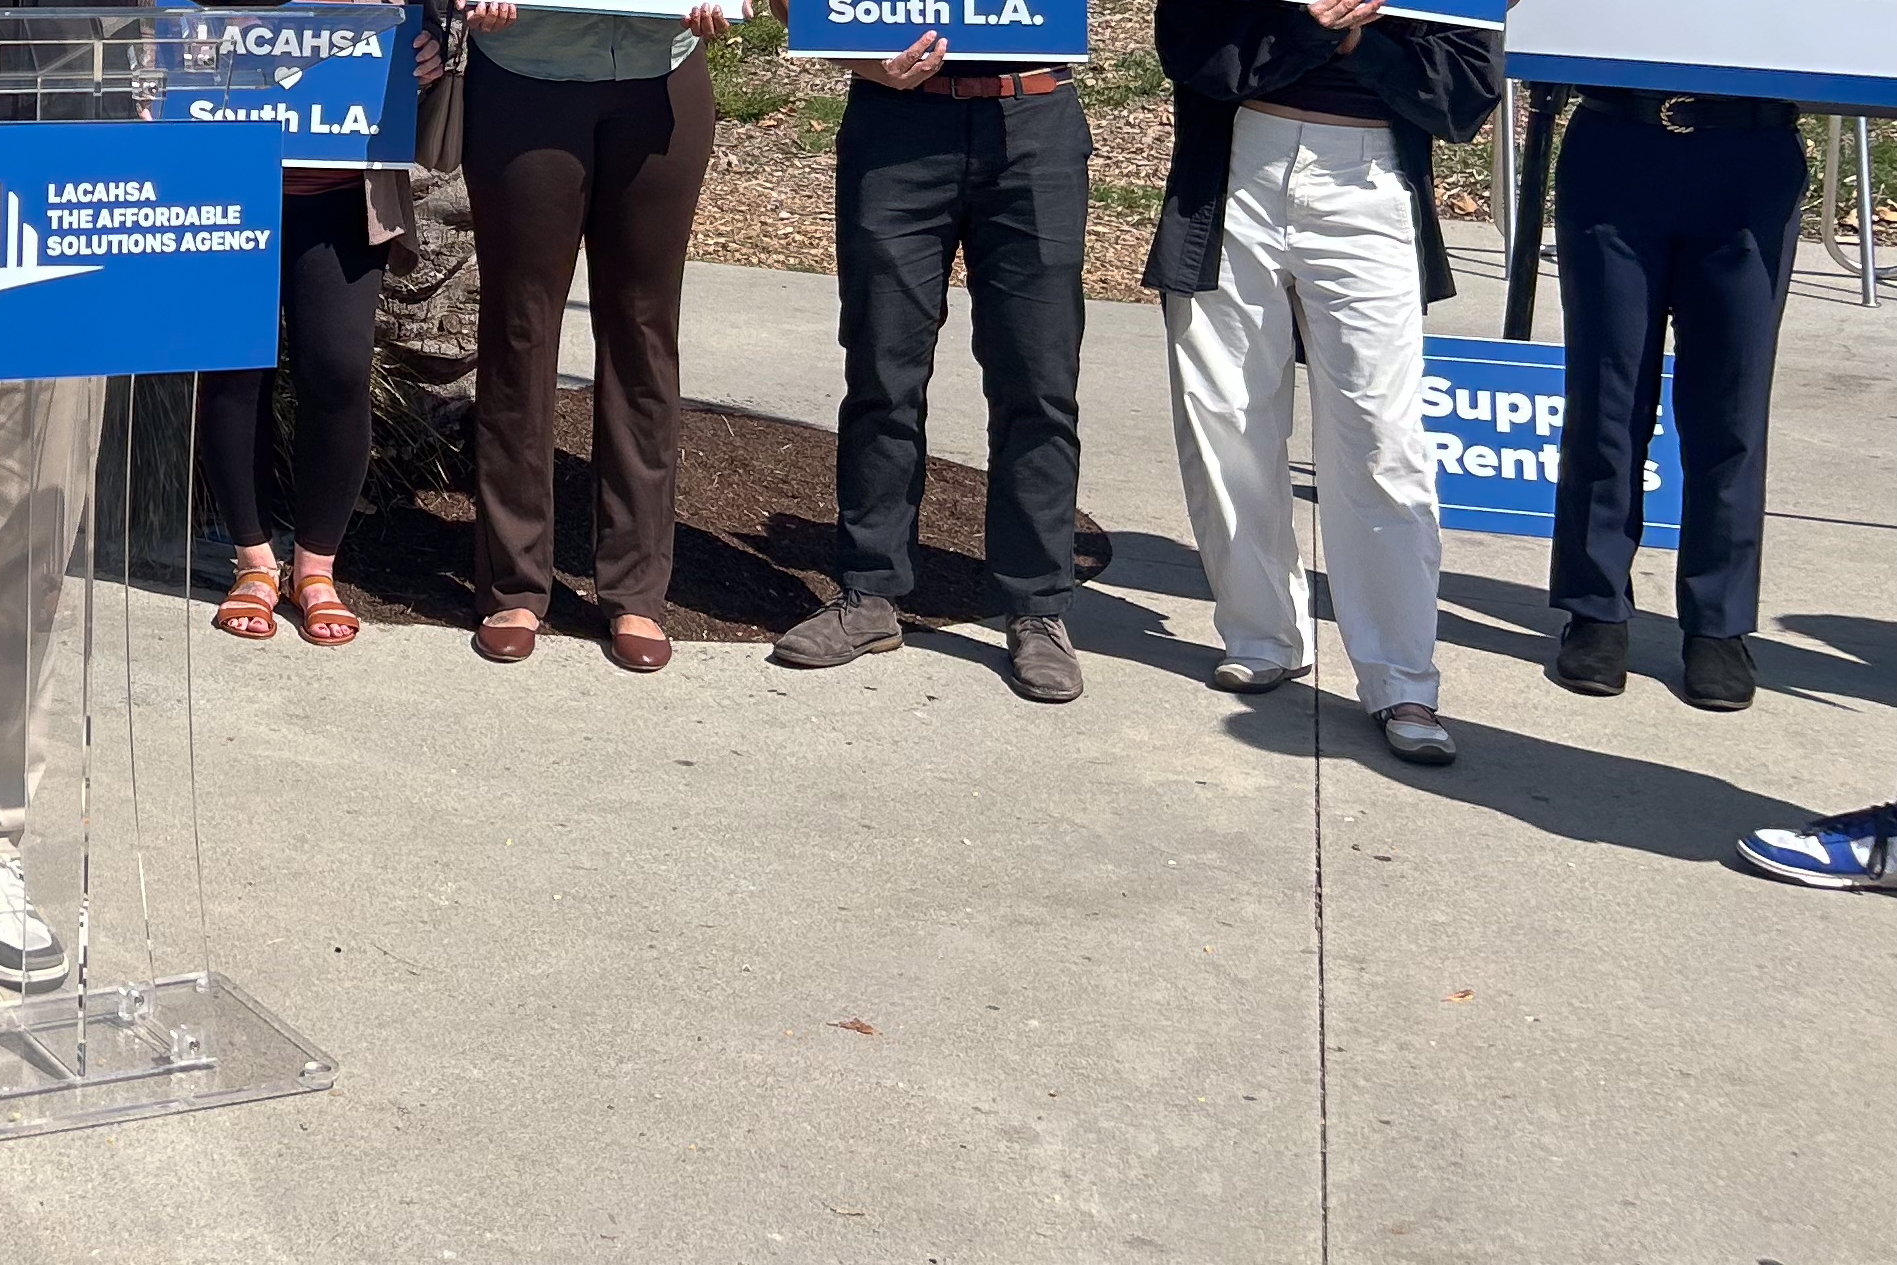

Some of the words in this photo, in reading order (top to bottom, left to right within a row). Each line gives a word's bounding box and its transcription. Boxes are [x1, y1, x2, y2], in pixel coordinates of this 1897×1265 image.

[310, 103, 380, 135] L.A.
[47, 181, 157, 204] LACAHSA
[46, 208, 94, 230] THE
[95, 204, 242, 229] AFFORDABLE
[45, 232, 177, 257] SOLUTIONS
[179, 229, 271, 252] AGENCY
